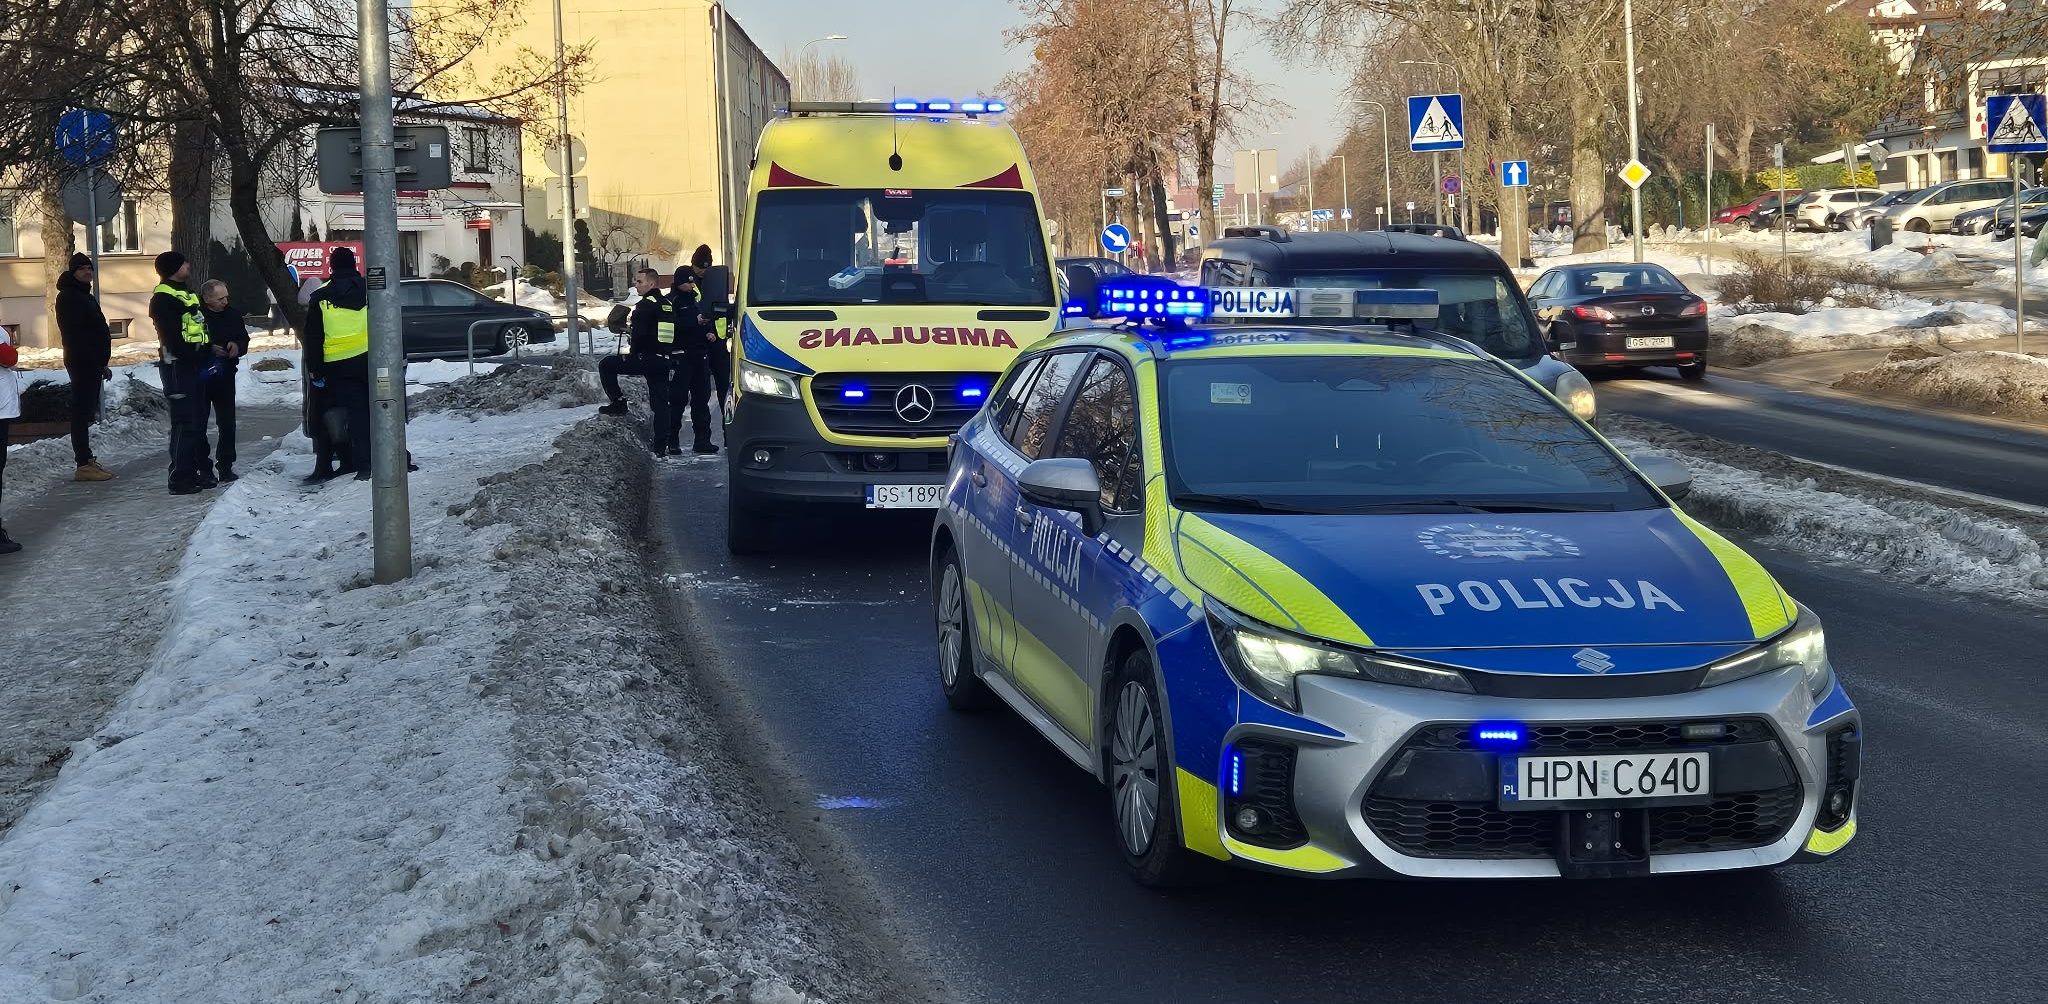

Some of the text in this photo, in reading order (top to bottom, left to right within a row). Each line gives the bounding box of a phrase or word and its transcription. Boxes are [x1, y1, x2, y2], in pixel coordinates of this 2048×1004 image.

[1211, 291, 1294, 313] POLICJA
[877, 486, 899, 503] GS
[1030, 509, 1083, 593] POLICJA
[1415, 577, 1685, 616] POLICJA
[1503, 784, 1517, 796] PL
[1527, 757, 1701, 798] HPN C640
